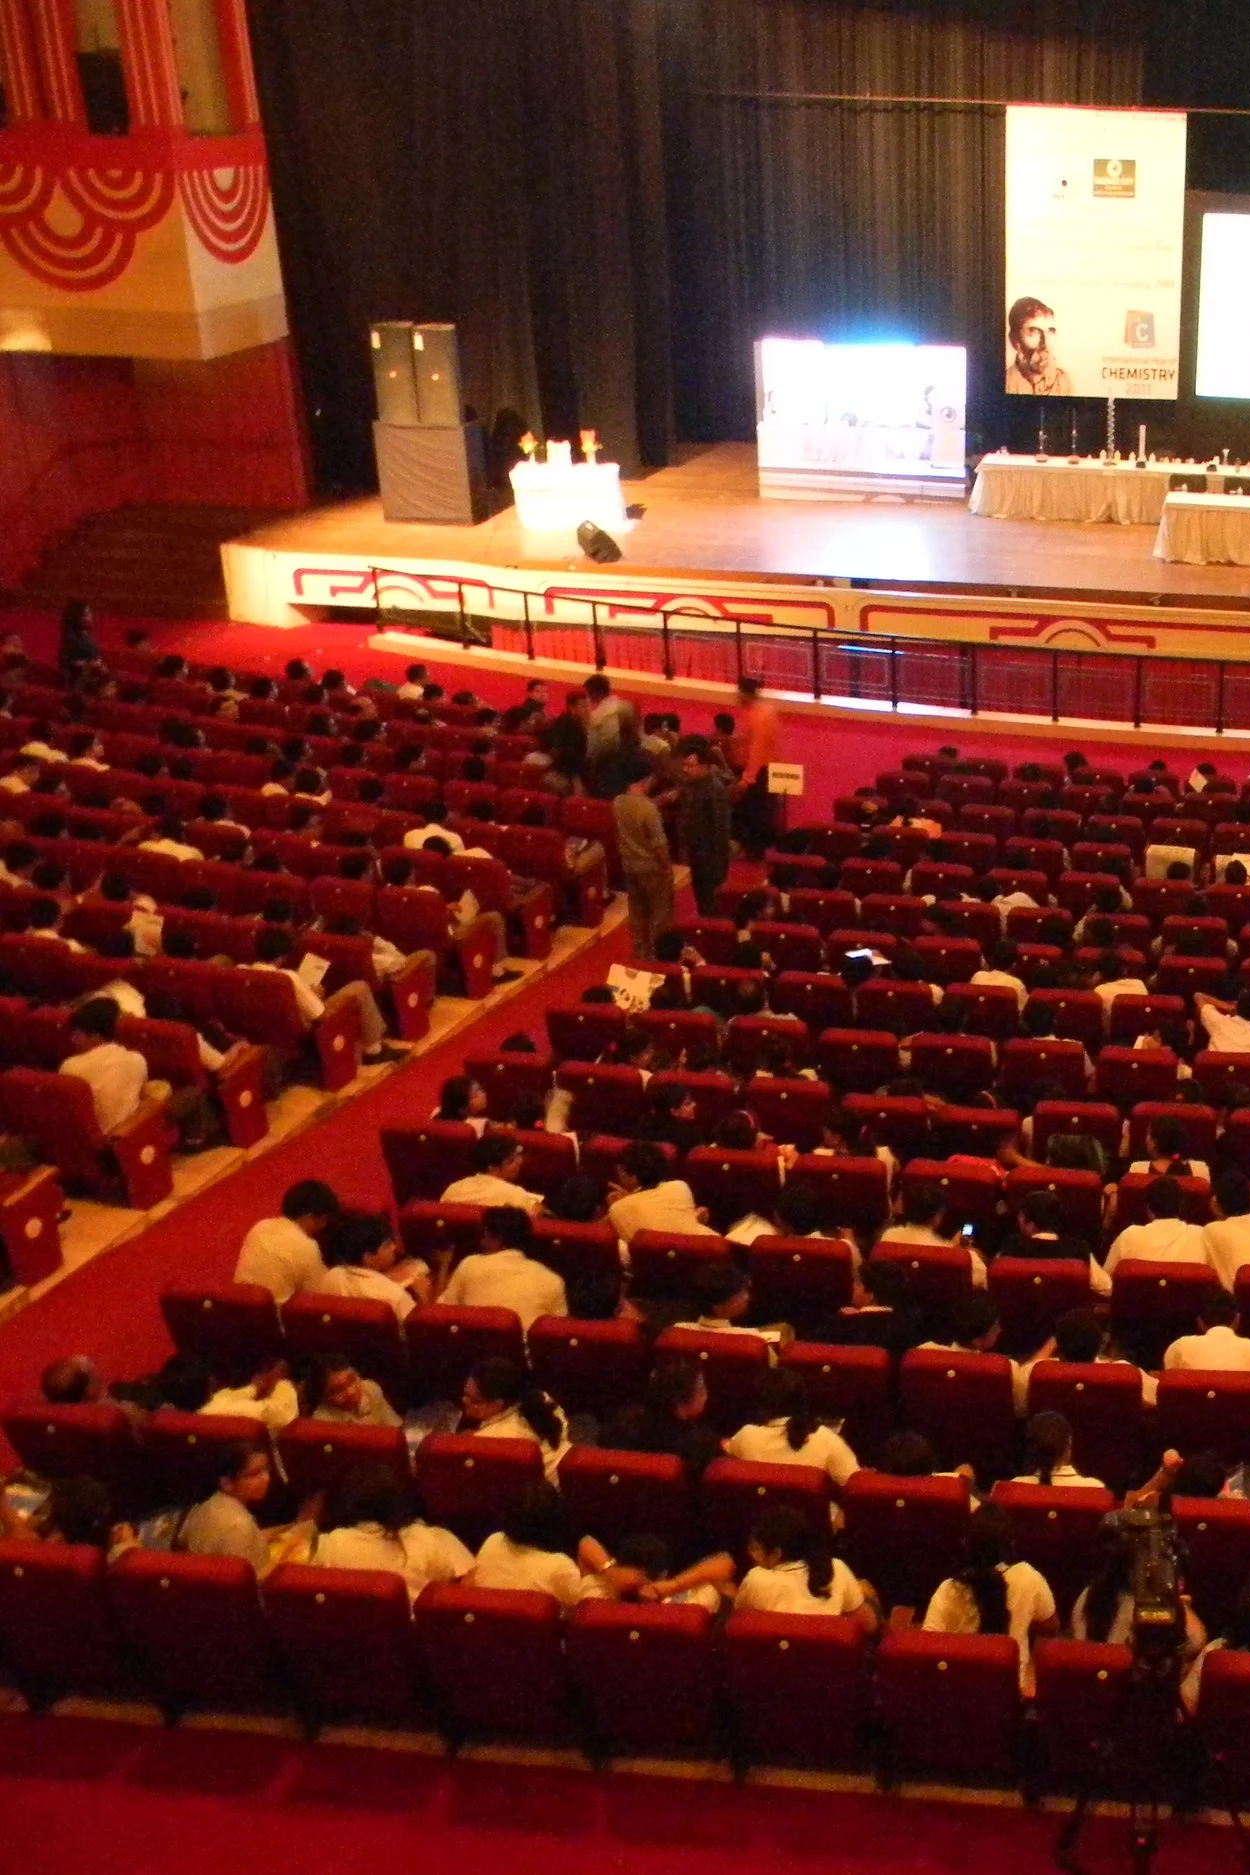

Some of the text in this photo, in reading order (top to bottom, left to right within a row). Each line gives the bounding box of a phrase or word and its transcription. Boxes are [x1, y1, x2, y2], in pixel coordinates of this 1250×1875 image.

[1136, 323, 1149, 342] C
[1101, 366, 1176, 381] CHEMISTRY
[1125, 383, 1152, 395] 2011
